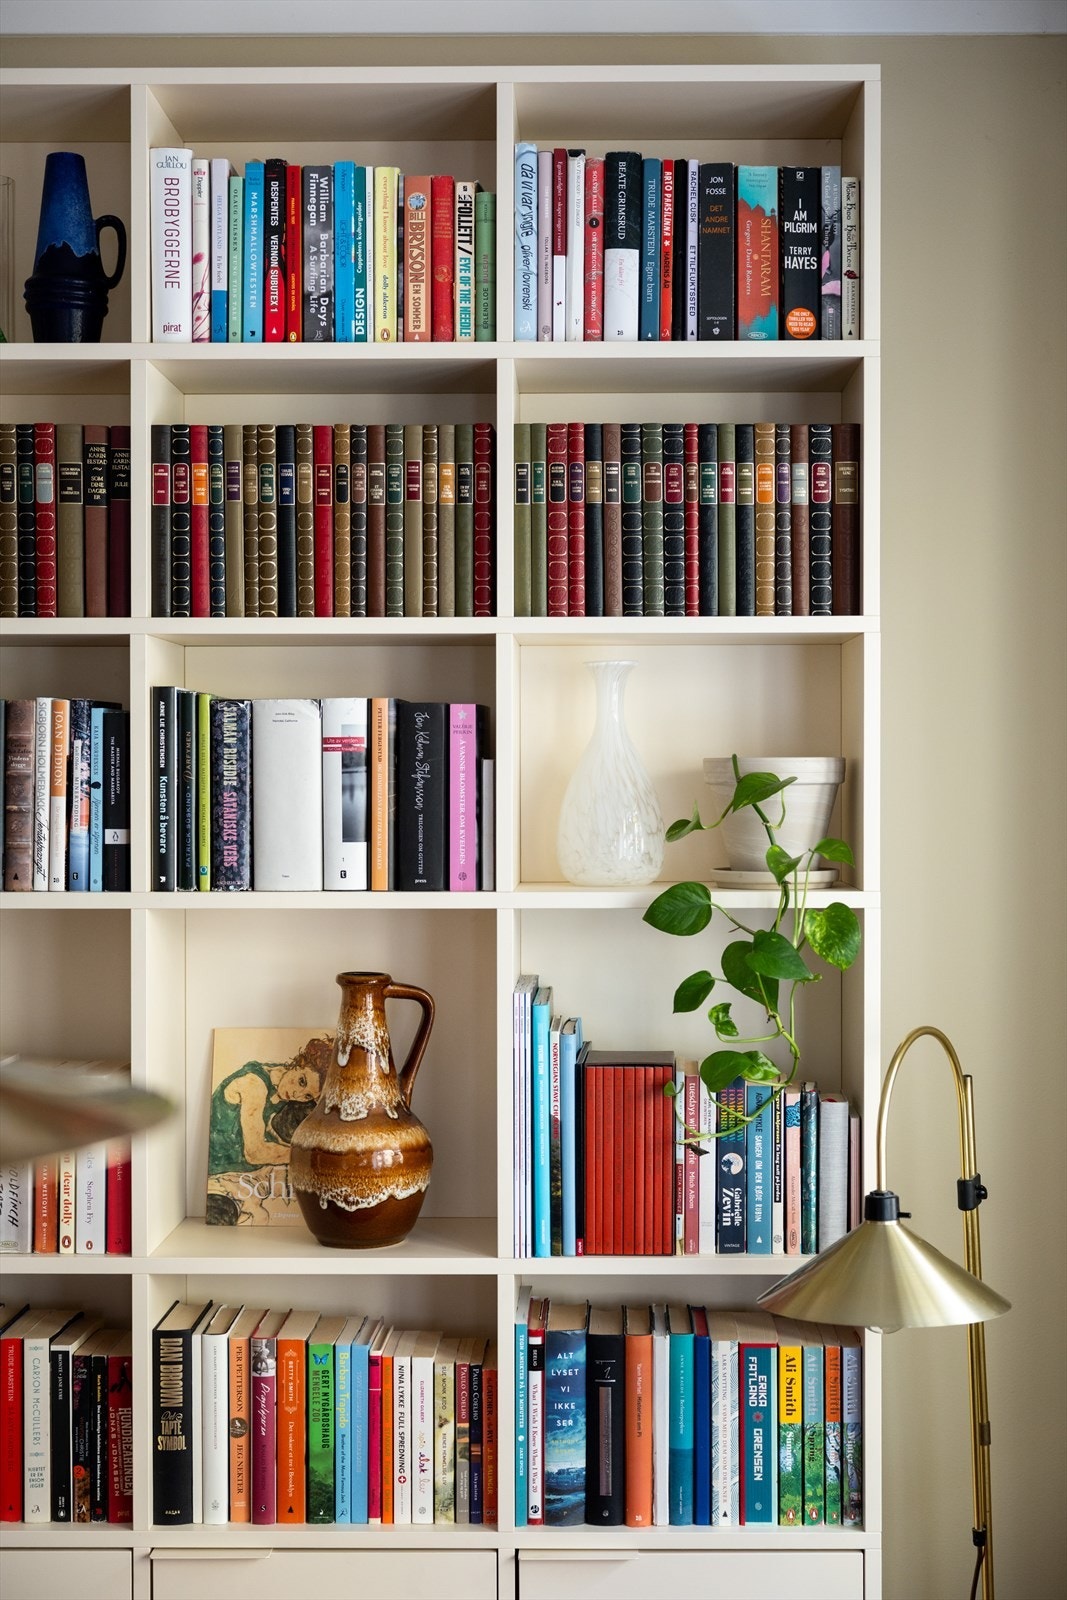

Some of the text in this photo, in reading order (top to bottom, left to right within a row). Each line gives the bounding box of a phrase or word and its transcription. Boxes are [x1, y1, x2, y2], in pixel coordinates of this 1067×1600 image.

[308, 173, 318, 226] Finnegan
[320, 177, 328, 222] William
[618, 162, 626, 239] BEATE GRIMSRUD
[794, 211, 807, 221] AM
[799, 199, 801, 208] I
[165, 177, 180, 289] BROBYGGERNE
[249, 192, 258, 308] MARSHMALLOWTESTEN
[409, 212, 425, 283] BILL BRYSON
[690, 245, 695, 253] ET
[785, 222, 817, 233] PILGRIM
[308, 256, 317, 292] Surfing
[646, 262, 654, 280] Egne
[760, 219, 771, 296] SHANTARAM
[785, 256, 817, 269] HAYES
[789, 247, 812, 255] TERRY
[318, 234, 328, 326] Barbarian Days
[460, 257, 471, 336] EYE OF THE NEEDLE
[163, 323, 181, 333] pirat
[355, 288, 364, 334] DESIGN
[413, 284, 421, 330] EN SOMMER
[37, 702, 47, 811] SIGBJØRN HOLMEBAKK
[54, 711, 63, 786] JOAN DIDION
[223, 706, 237, 785] SALMAN RUSHDIE
[159, 776, 168, 813] Kunsten
[160, 823, 168, 853] bevare
[224, 792, 237, 867] SATANISKE VERS
[754, 1135, 762, 1157] SANGEN
[754, 1161, 762, 1169] OM
[62, 1172, 72, 1225] dear dolly
[85, 1181, 93, 1224] Stephen Fry
[722, 1188, 742, 1226] Gabrielle Zevin
[754, 1186, 763, 1201] RØDE
[160, 1338, 183, 1407] DAN BROWN
[336, 1352, 349, 1429] Barbara Trapido
[472, 1368, 480, 1421] PAULO COELHO
[748, 1356, 757, 1407] FATLAND
[758, 1375, 767, 1407] ERIKA
[785, 1354, 796, 1416] Ali Smith
[807, 1354, 817, 1416] Ali Smith
[830, 1354, 840, 1415] Ali Smith
[847, 1354, 859, 1415] Ali Smith
[32, 1358, 41, 1446] CARSON McCULLERS
[312, 1371, 320, 1423] MENGELE ZOO
[321, 1370, 332, 1449] GERT NYGÅRDSHAUG
[460, 1390, 468, 1419] COELHO
[157, 1436, 187, 1451] SYMBOL
[161, 1421, 182, 1435] TAPTE
[785, 1431, 794, 1471] Summer
[808, 1430, 817, 1462] Spring
[846, 1430, 856, 1463] Winter
[111, 1443, 119, 1497] JONASSON
[398, 1431, 406, 1474] SPREDNING
[753, 1428, 762, 1481] GRENSEN
